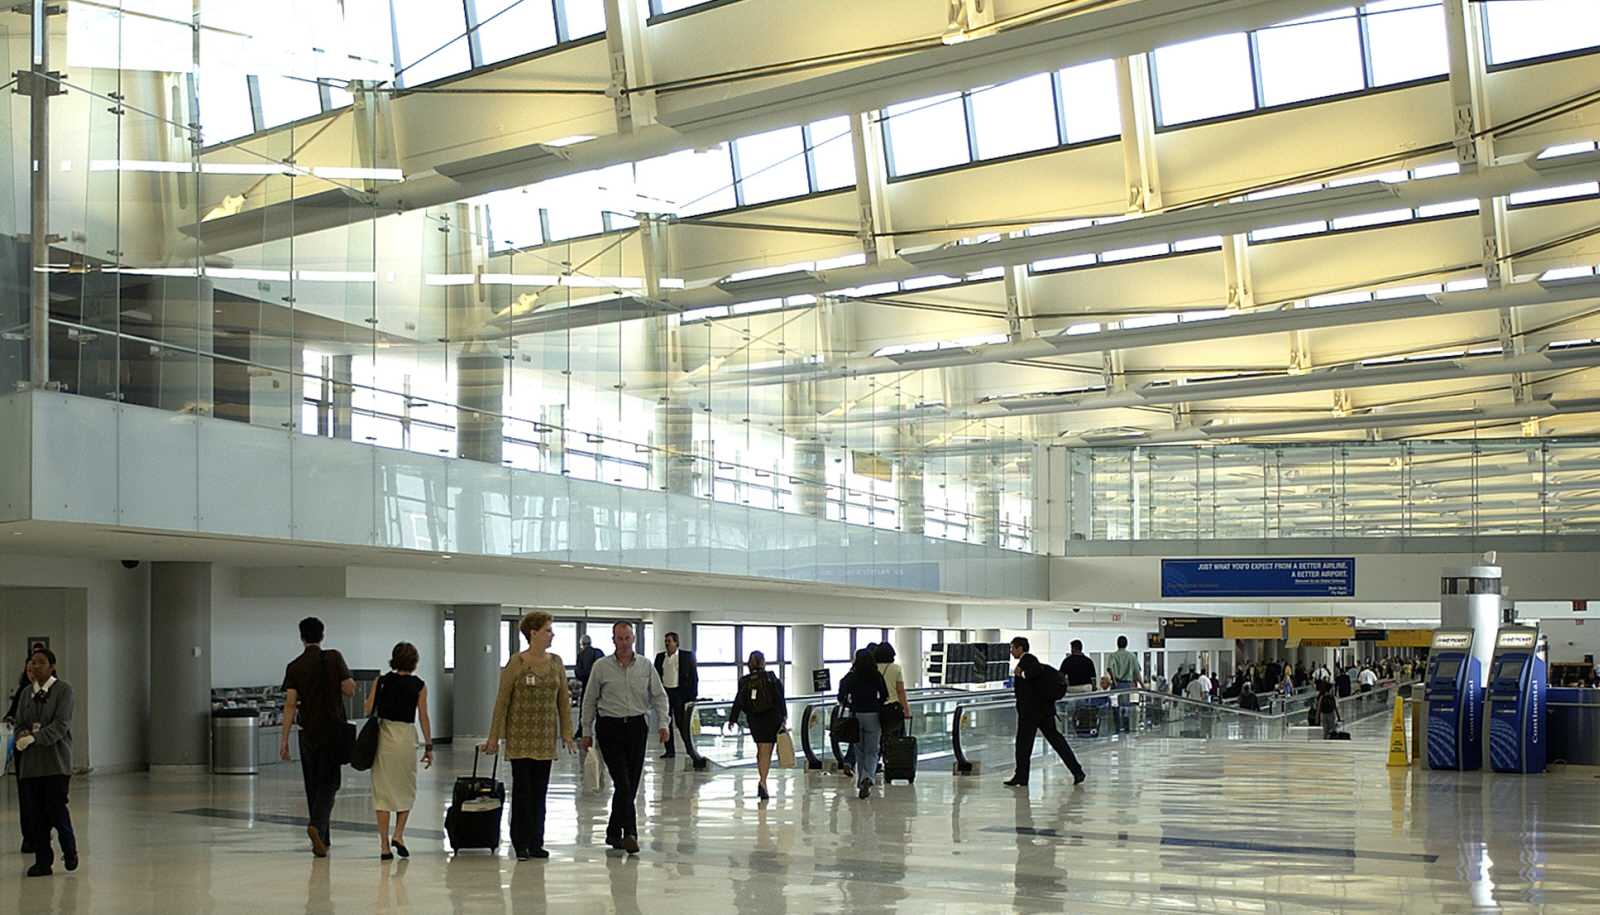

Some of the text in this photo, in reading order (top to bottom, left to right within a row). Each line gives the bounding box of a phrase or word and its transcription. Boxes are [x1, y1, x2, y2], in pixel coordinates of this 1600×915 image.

[1198, 562, 1213, 570] JUST
[1214, 562, 1230, 570] WHAT
[1232, 562, 1249, 570] YOU'D
[1251, 562, 1273, 570] EXPECT
[1274, 562, 1292, 570] FROM
[1291, 570, 1297, 578] A
[1297, 570, 1320, 578] BETTER
